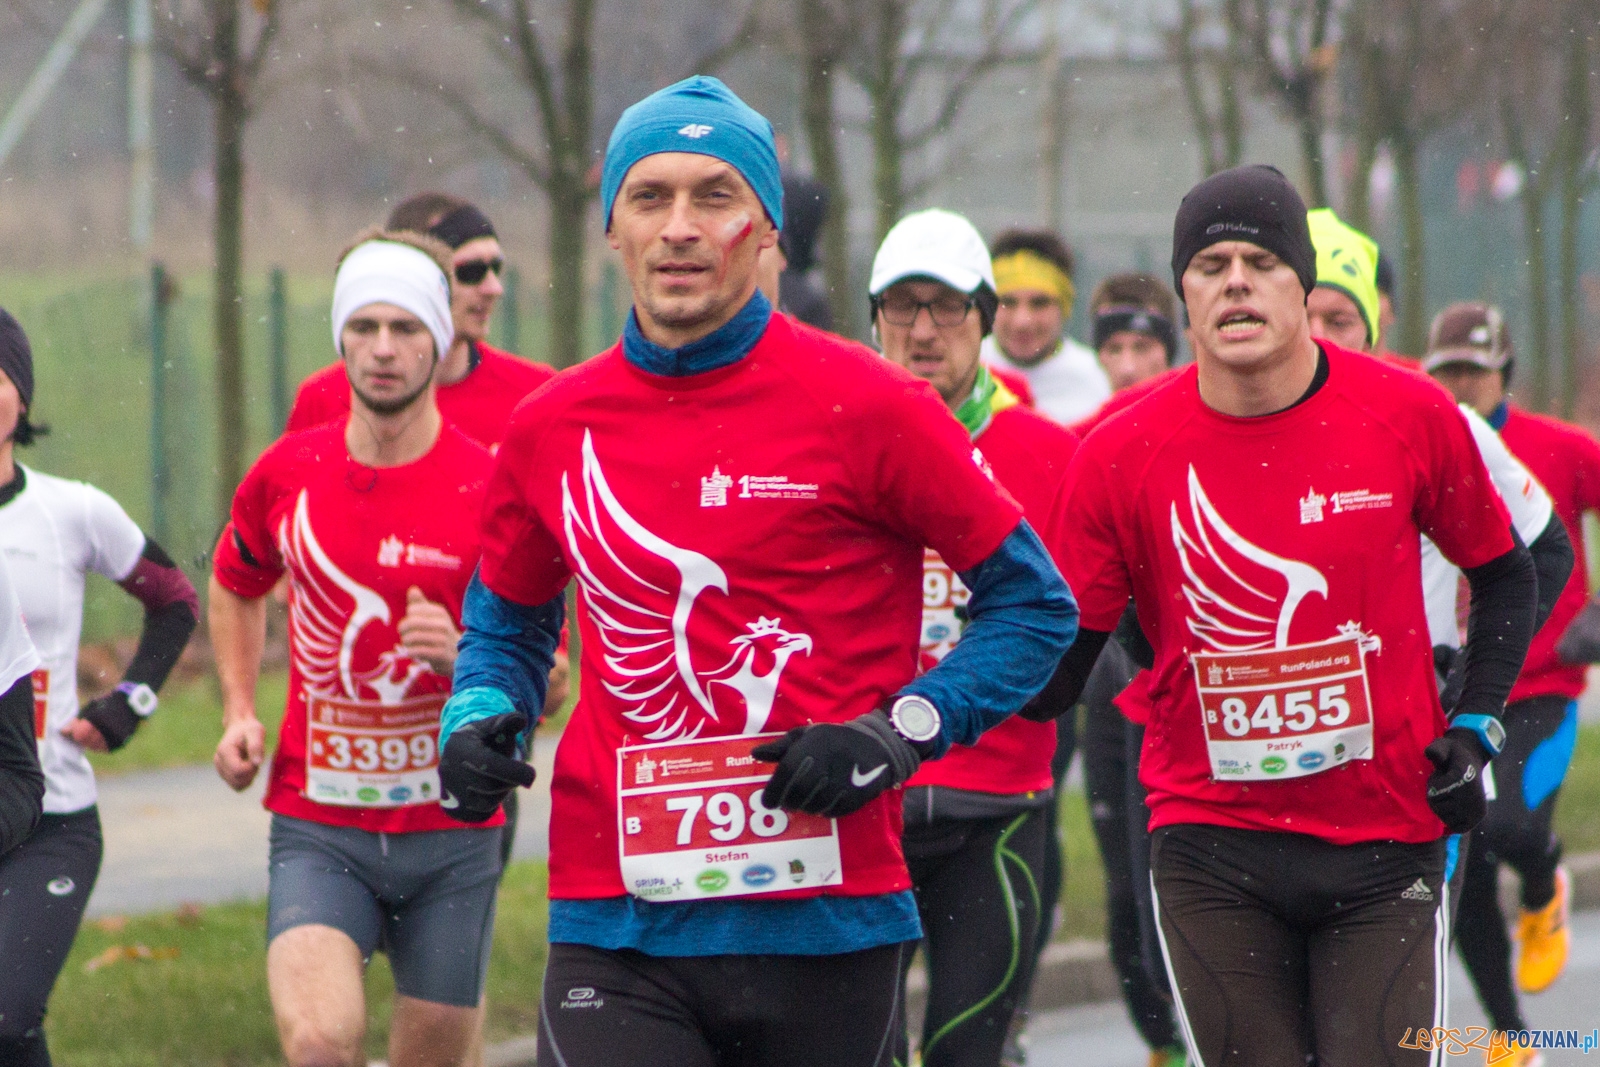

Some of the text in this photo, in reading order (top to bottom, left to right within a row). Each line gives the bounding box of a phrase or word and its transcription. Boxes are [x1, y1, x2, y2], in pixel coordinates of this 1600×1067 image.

[677, 123, 714, 138] 4F
[738, 474, 752, 498] 1
[1280, 655, 1350, 673] RunPoland.org
[1207, 710, 1217, 724] B
[1221, 684, 1350, 737] 8455
[326, 734, 435, 771] 3399
[1267, 740, 1303, 751] Patryk
[666, 788, 788, 845] 798
[626, 817, 641, 834] B
[705, 851, 749, 863] Stefan
[1401, 890, 1434, 901] adidas
[560, 998, 604, 1009] Kalenji
